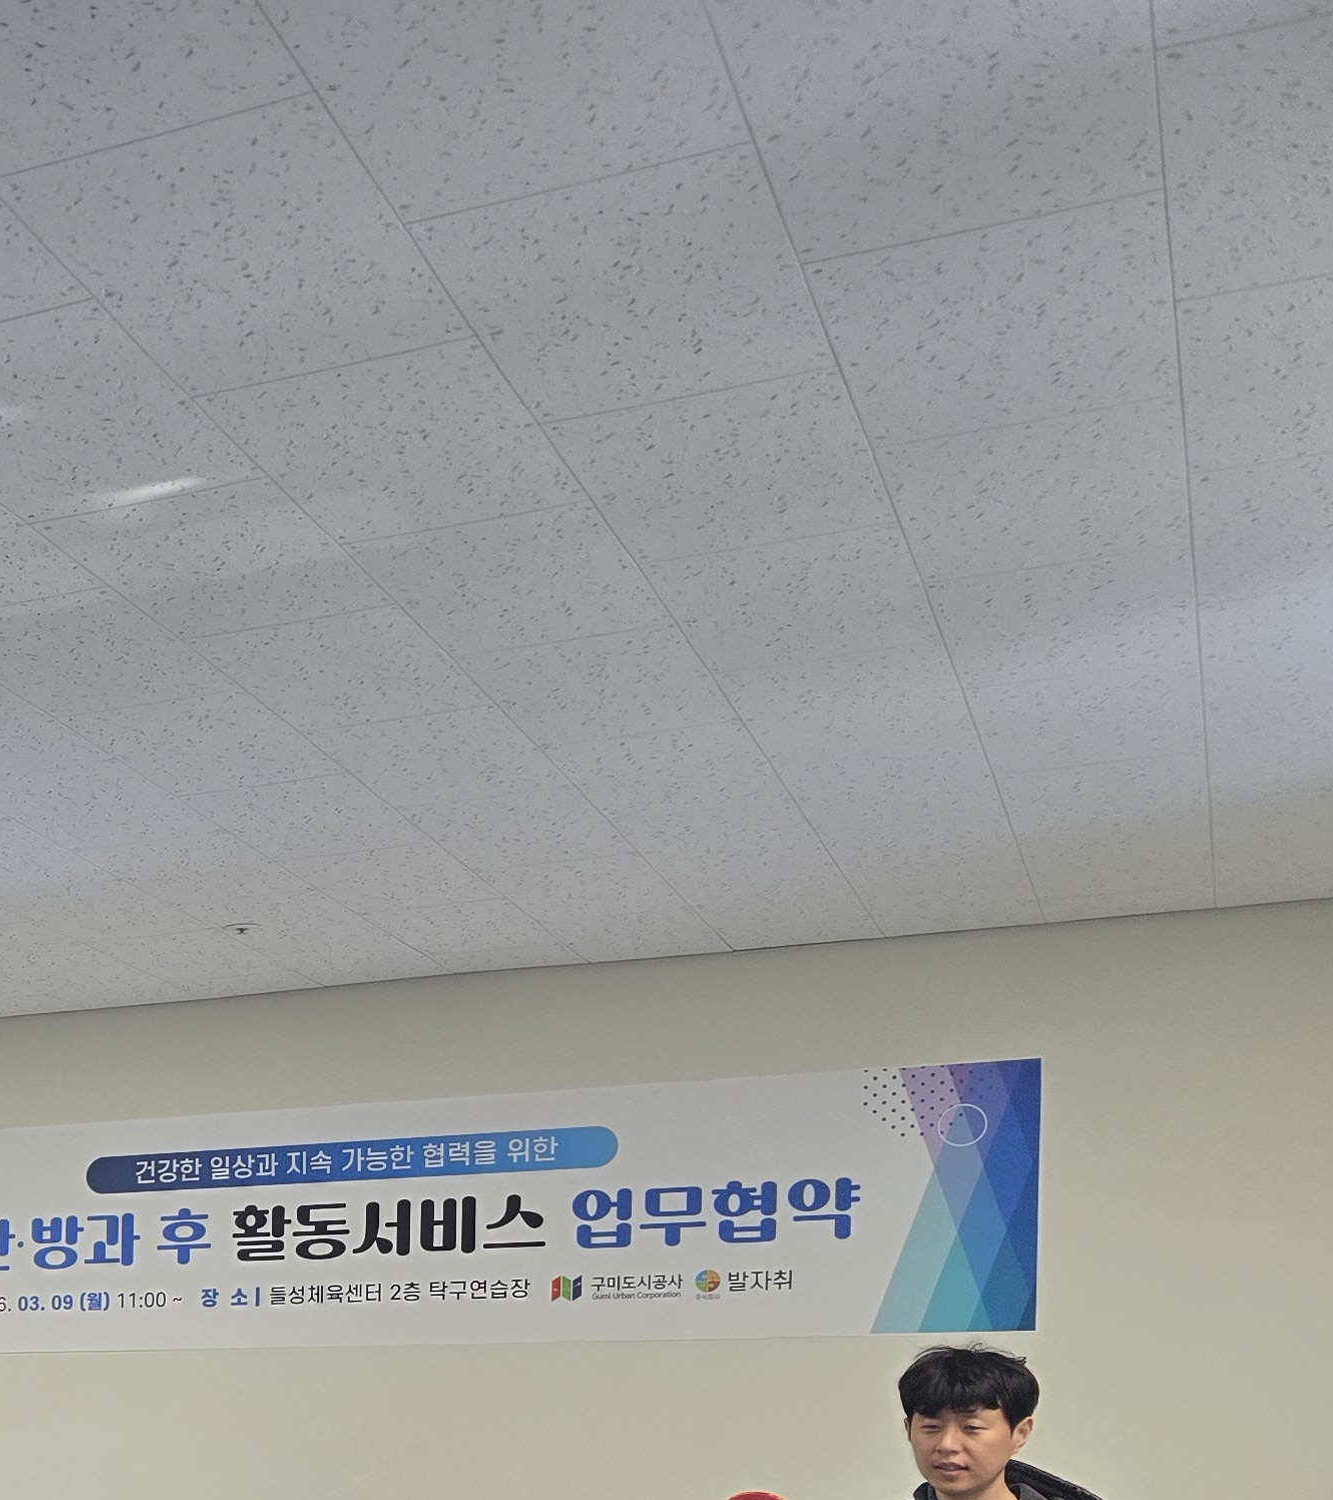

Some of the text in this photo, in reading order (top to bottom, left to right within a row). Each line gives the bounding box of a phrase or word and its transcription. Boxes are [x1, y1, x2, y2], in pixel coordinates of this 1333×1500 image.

[136, 1135, 559, 1184] 건강한 일상과 지속 가능한 협력을 위한
[156, 1207, 212, 1265] 후
[232, 1194, 546, 1262] 활동서비스
[572, 1177, 861, 1249] 업무협약
[591, 1274, 683, 1292] 구미도시공사
[727, 1269, 794, 1292] 발자취
[18, 1296, 45, 1311] 03.
[51, 1294, 74, 1311] 09
[79, 1291, 111, 1312] (월)
[117, 1291, 167, 1309] 11:00
[201, 1288, 219, 1308] 장
[269, 1283, 382, 1306] 들성체육센터
[390, 1281, 421, 1302] 2층
[429, 1278, 531, 1301] 탁구연습장
[613, 1291, 635, 1300] Urban
[637, 1290, 681, 1300] Corporation
